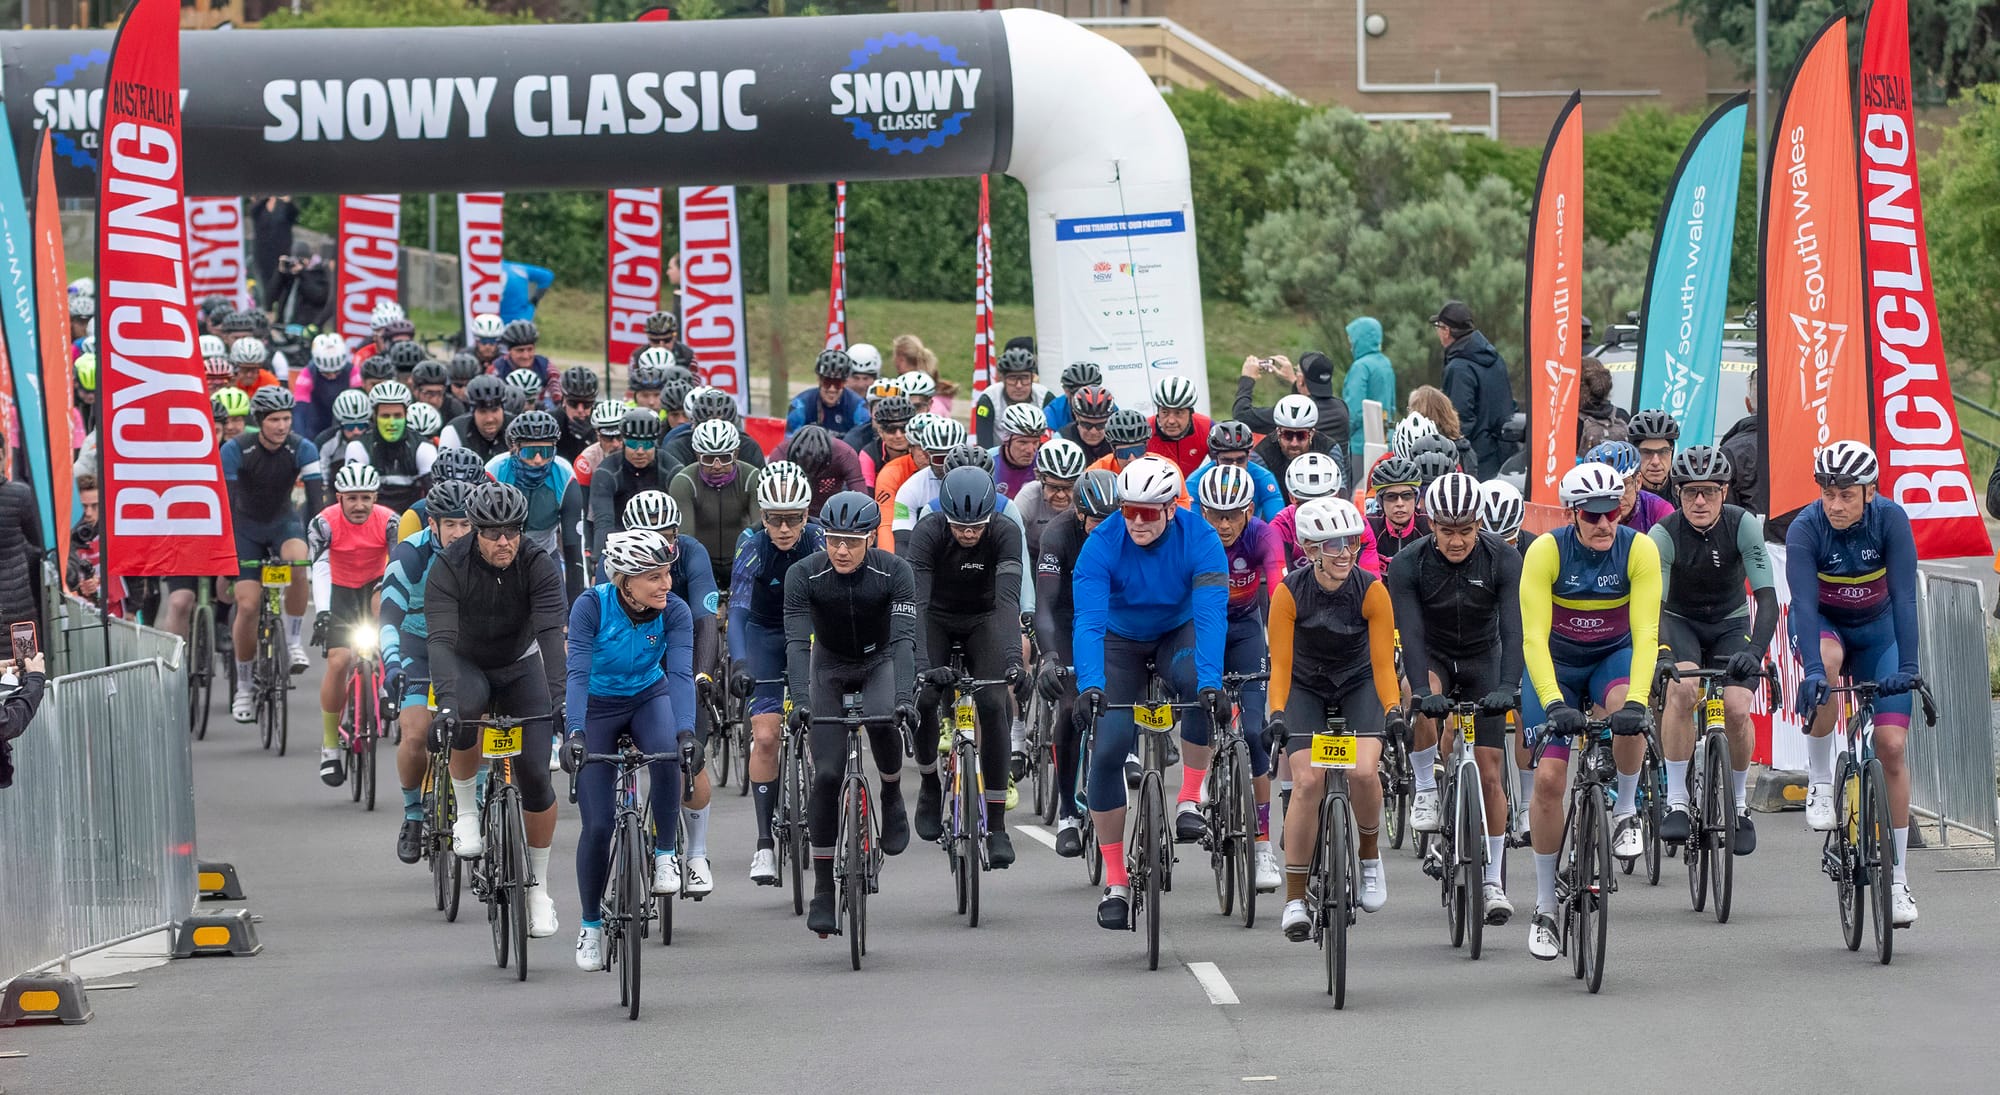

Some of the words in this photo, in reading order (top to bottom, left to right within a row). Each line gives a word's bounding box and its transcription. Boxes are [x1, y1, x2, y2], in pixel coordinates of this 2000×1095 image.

[263, 78, 498, 142] SNOWY
[513, 69, 757, 138] CLASSIC
[830, 69, 982, 115] SNOWY
[878, 113, 936, 131] CLASSIC
[1788, 125, 1812, 220] wales
[1687, 184, 1706, 270] wales
[685, 186, 739, 395] BICYCLIN
[1793, 221, 1826, 312] south
[109, 121, 223, 536] BICYCLING
[1103, 307, 1159, 316] VOLVO
[1678, 273, 1697, 355] south
[1864, 113, 1979, 520] BICYCLING
[1812, 319, 1829, 391] new
[892, 604, 917, 616] RAPH
[1597, 574, 1619, 587] CPCC
[493, 738, 513, 748] 1579
[1143, 714, 1164, 724] 1168
[1323, 745, 1346, 756] 1736
